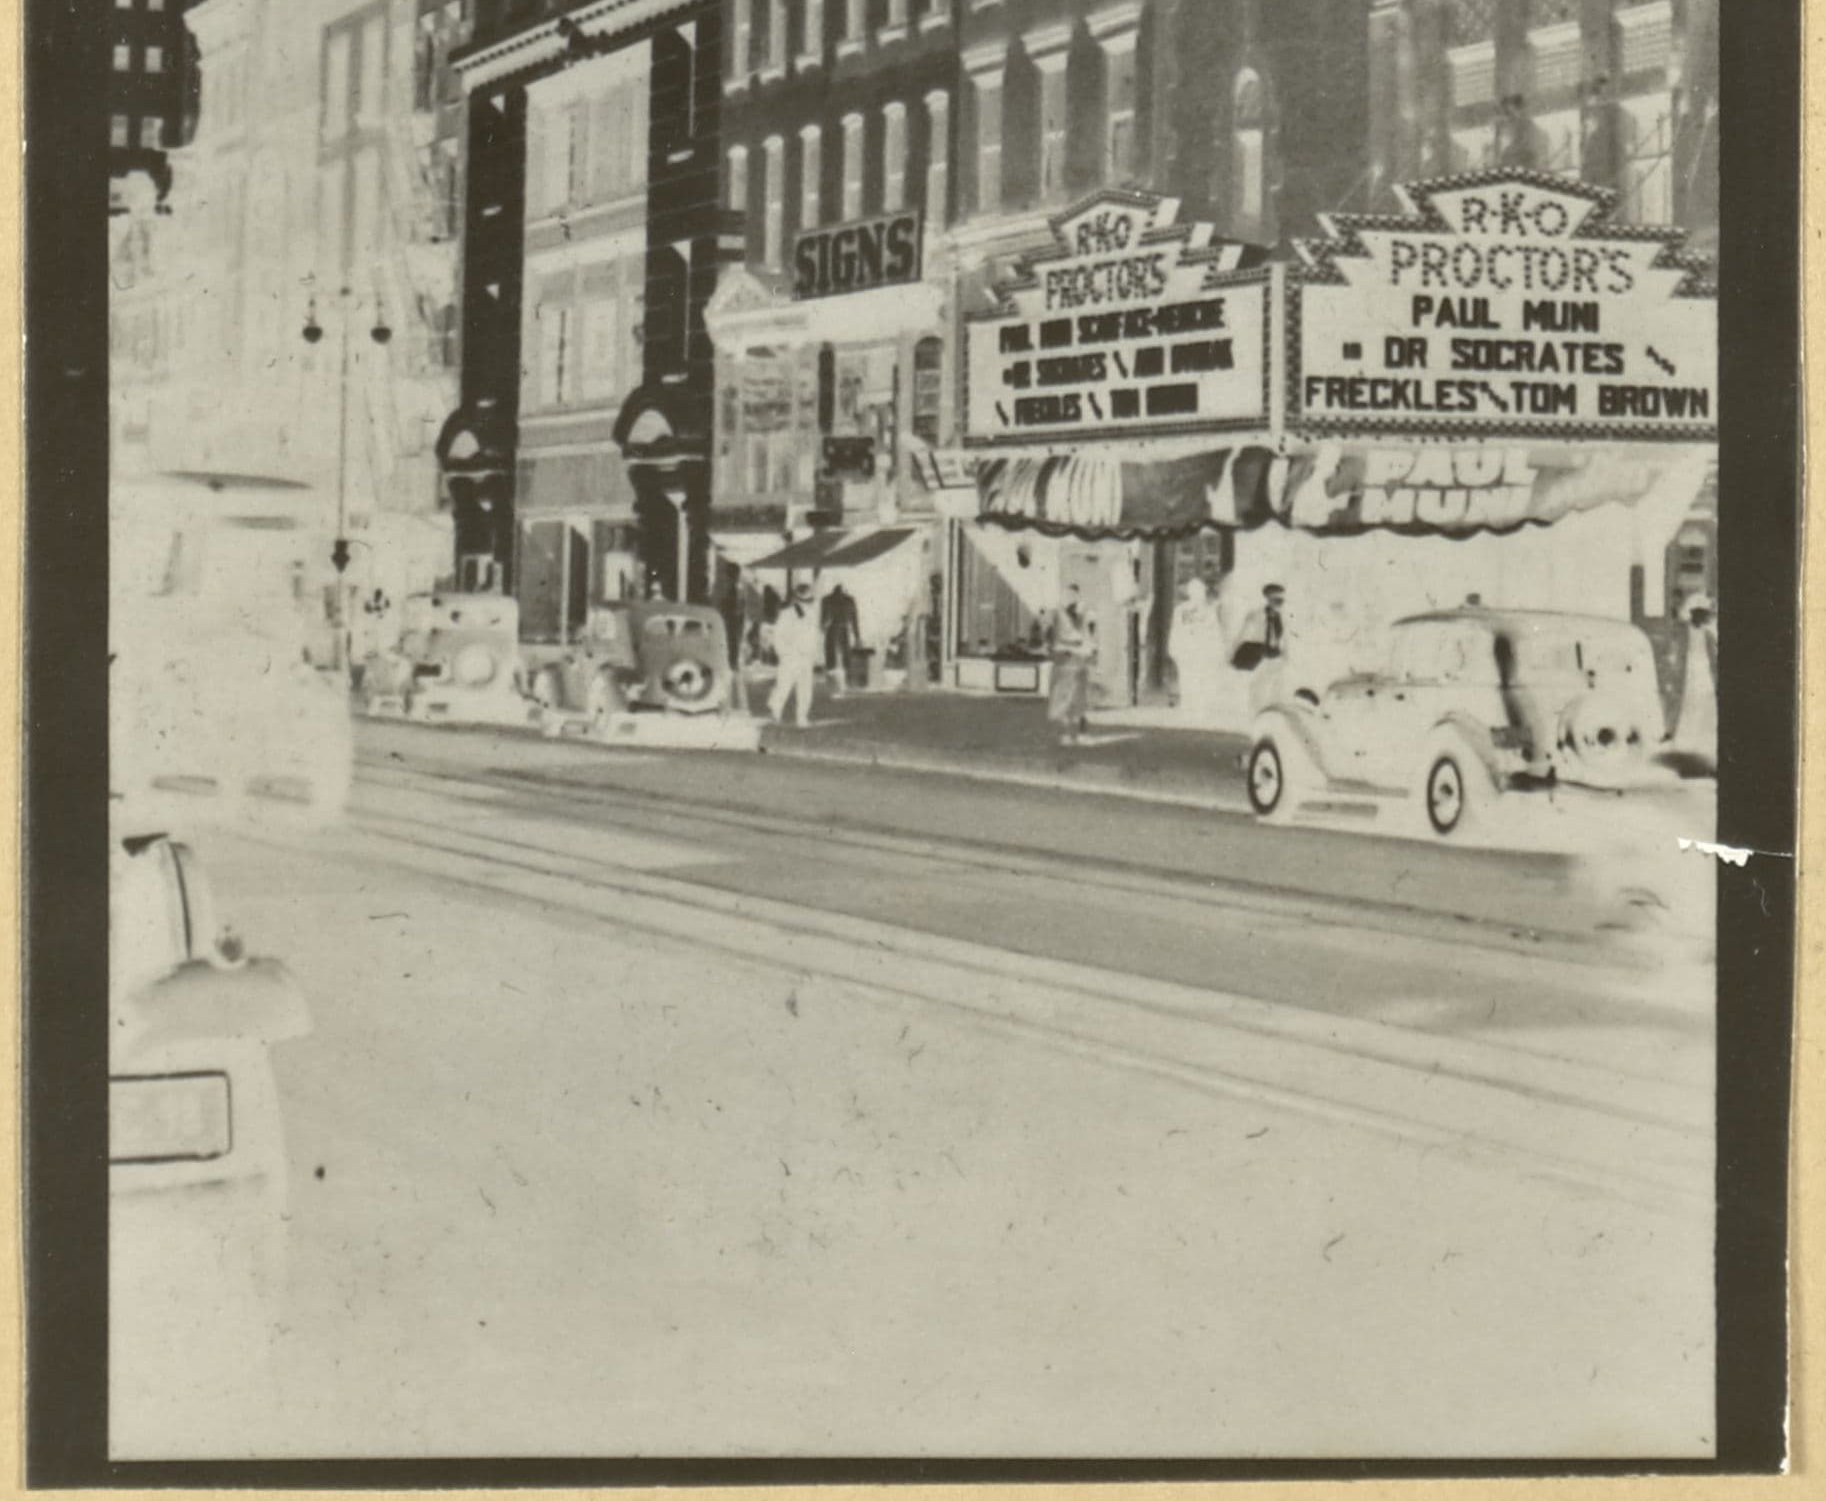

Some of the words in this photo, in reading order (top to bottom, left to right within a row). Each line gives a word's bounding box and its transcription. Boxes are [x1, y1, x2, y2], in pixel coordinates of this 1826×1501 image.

[796, 218, 914, 293] SIGNS
[1412, 296, 1500, 330] PAUL
[1523, 300, 1599, 333] MUNI
[1384, 337, 1427, 368] DR
[1451, 338, 1625, 374] SOCRATES
[1305, 377, 1477, 411] FRECKLES
[1510, 381, 1576, 415] TOM
[1598, 385, 1709, 418] BROWN
[1365, 450, 1538, 485] PAUL
[1360, 487, 1536, 525] MUNI
